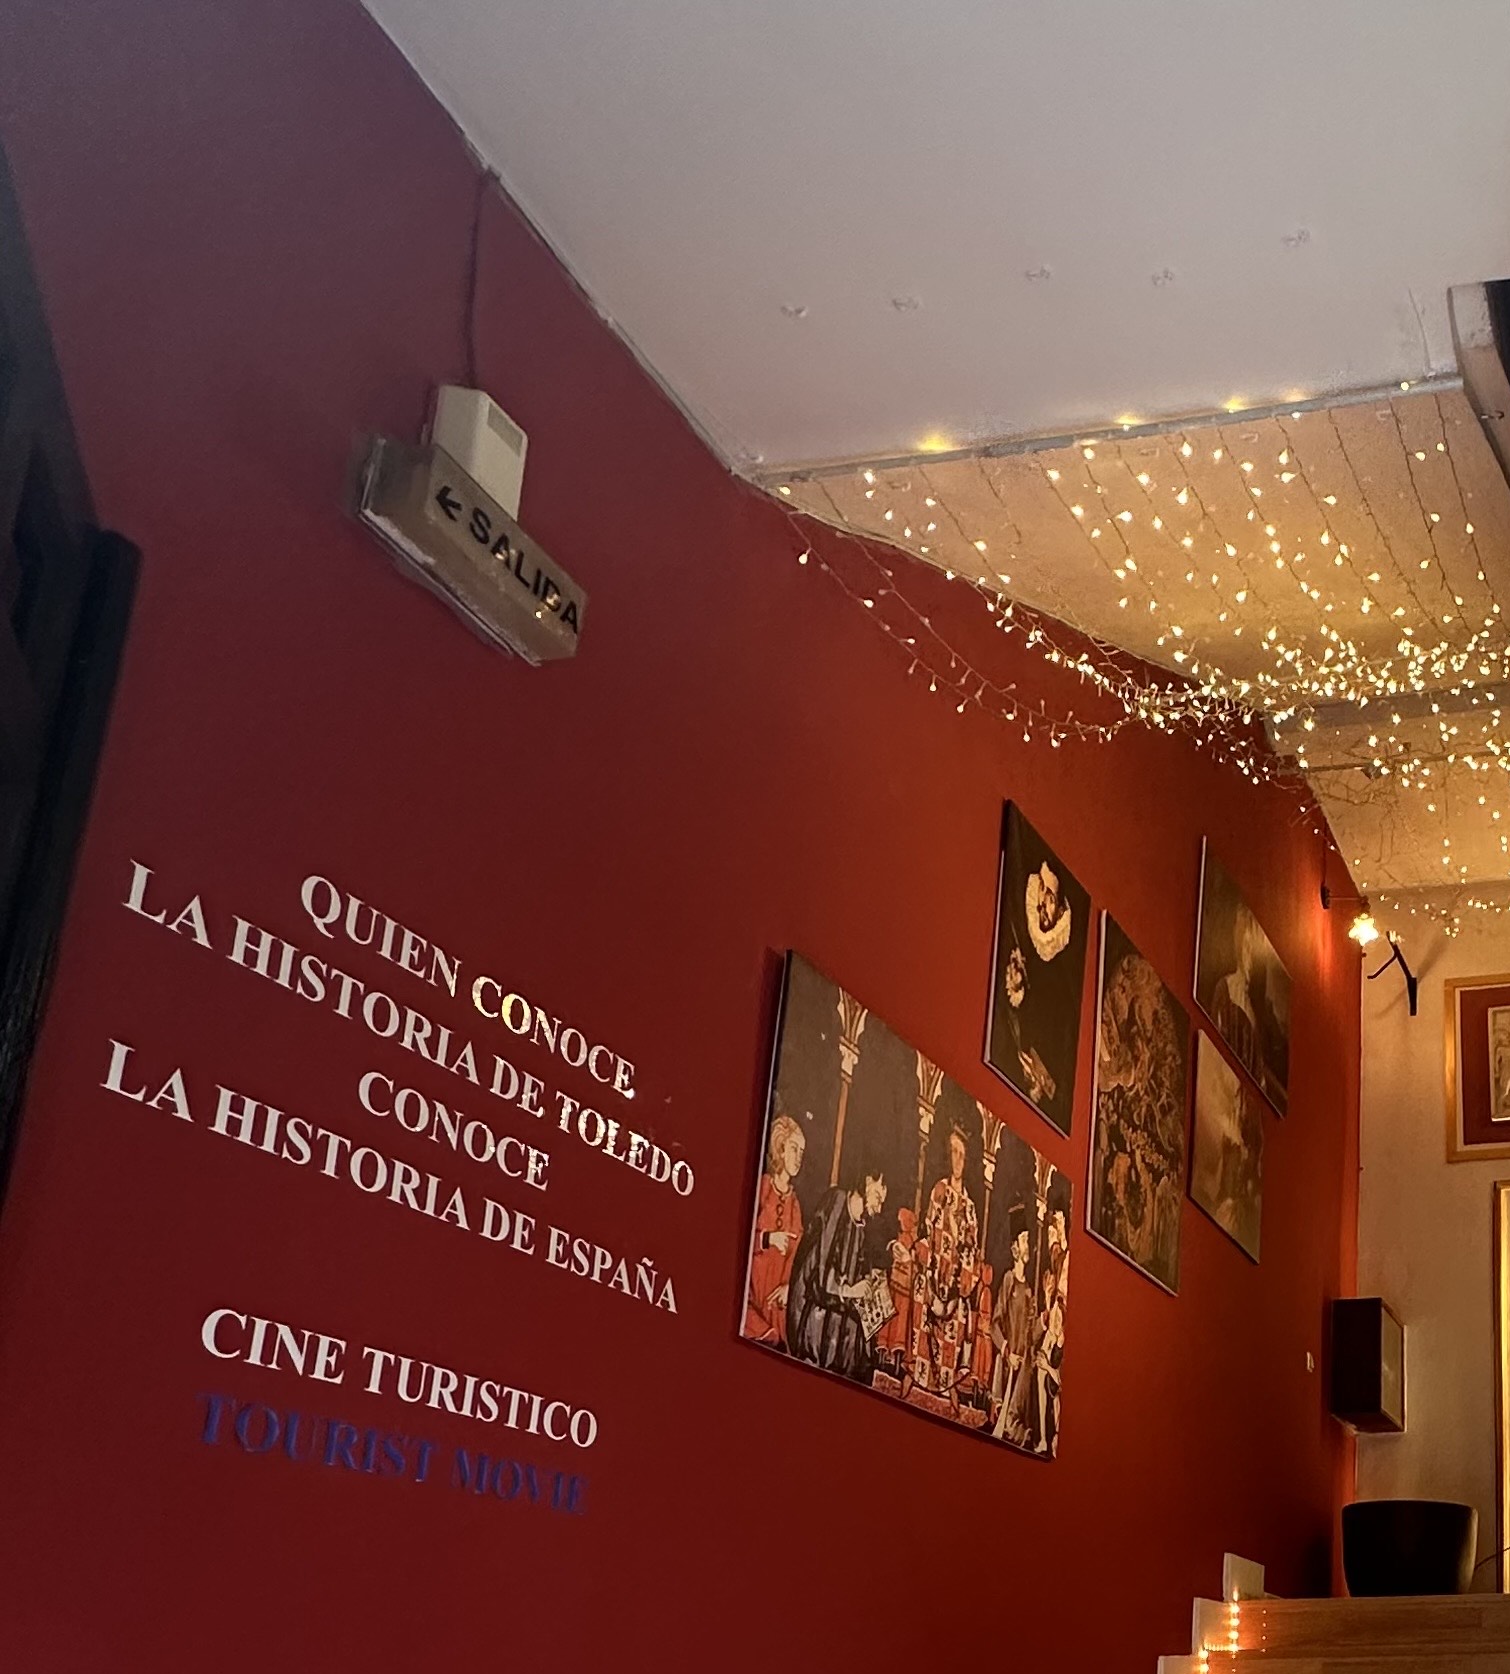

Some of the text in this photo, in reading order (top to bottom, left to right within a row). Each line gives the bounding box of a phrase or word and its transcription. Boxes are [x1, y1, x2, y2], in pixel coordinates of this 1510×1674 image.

[469, 507, 578, 634] SALIDA
[122, 859, 695, 1196] LA HISTORIA DE TOLEDO
[301, 875, 636, 1099] QUIEN CONOCE
[100, 1039, 679, 1314] LA HISTORIA DE ESPAÑA
[358, 1071, 550, 1192] CONOCE
[201, 1308, 598, 1448] CINE TURISTICO
[199, 1393, 590, 1515] TOURIST MOVIE
